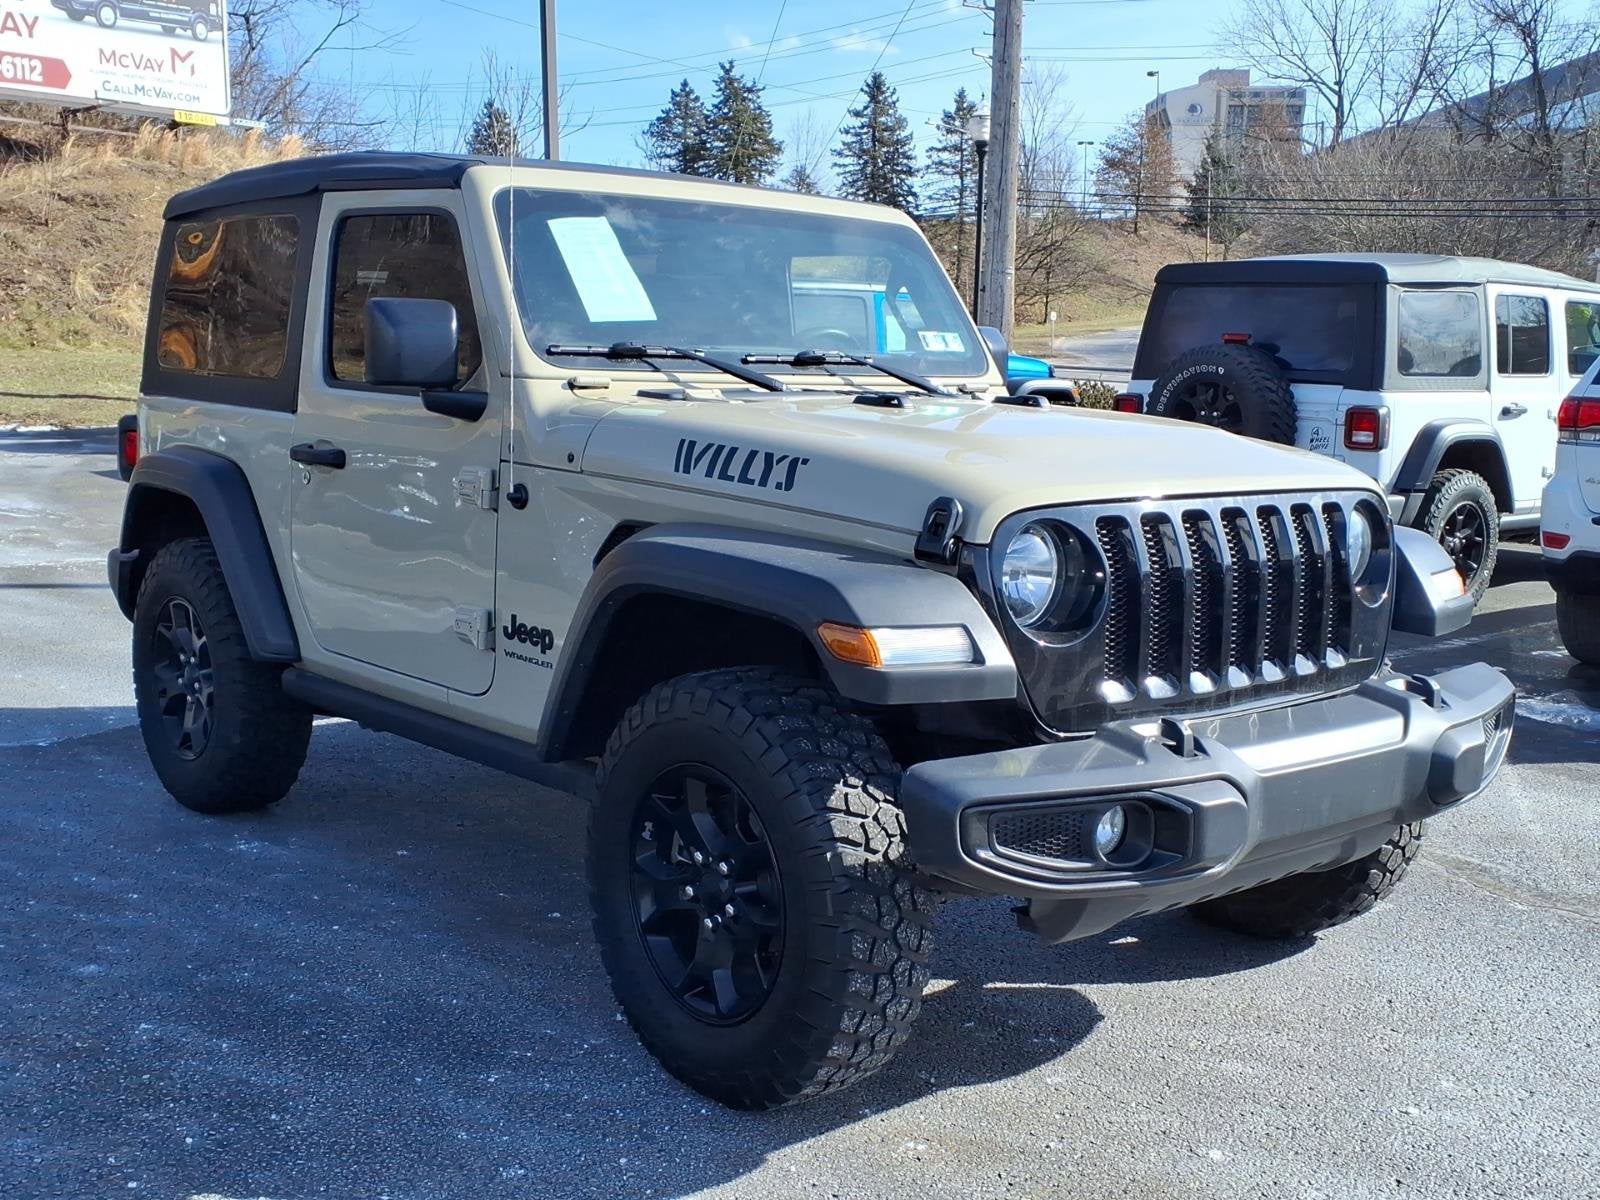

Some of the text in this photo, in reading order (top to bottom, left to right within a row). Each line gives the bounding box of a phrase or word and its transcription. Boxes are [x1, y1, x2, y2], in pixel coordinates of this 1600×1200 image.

[1157, 364, 1217, 411] DESTINATION
[1309, 436, 1330, 444] WHEEL
[1309, 443, 1329, 451] DRIVE
[673, 437, 810, 492] WILLYS
[502, 613, 554, 655] Jeep
[503, 648, 553, 669] WRANGLER
